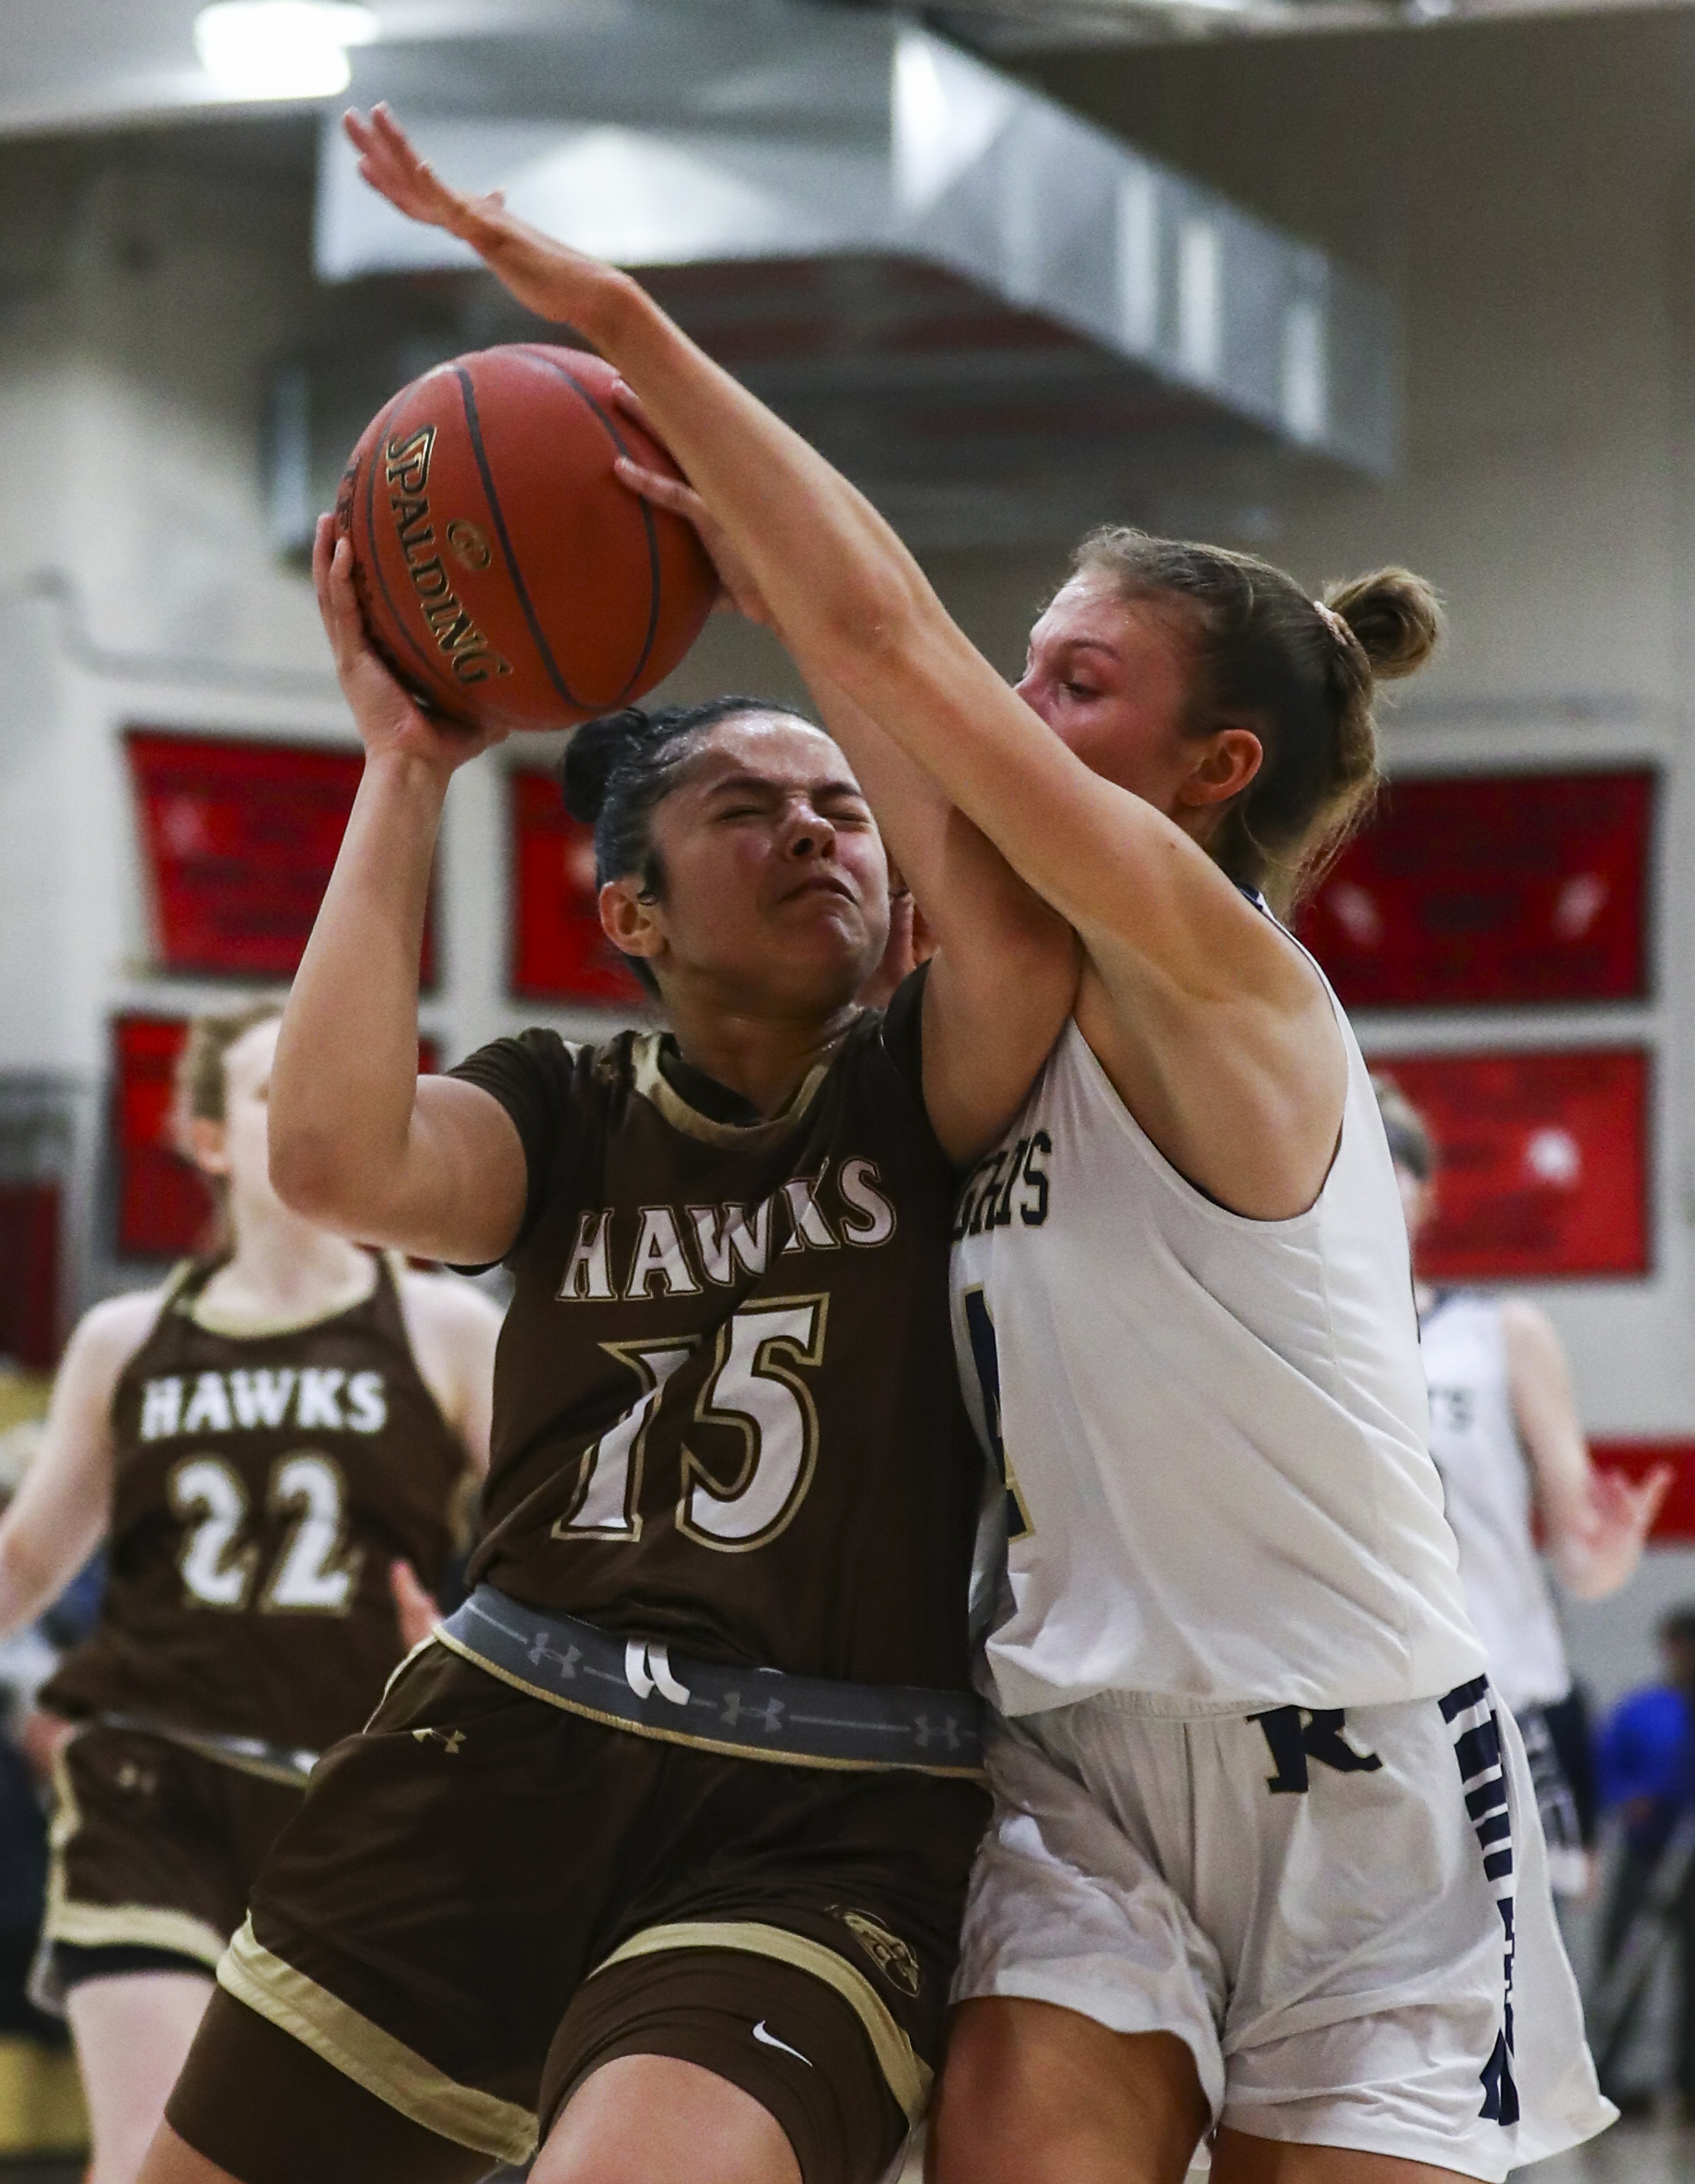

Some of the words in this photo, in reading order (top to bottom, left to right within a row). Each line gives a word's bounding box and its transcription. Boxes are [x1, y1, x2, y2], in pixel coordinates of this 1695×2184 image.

[386, 423, 513, 685] SPALDING
[555, 1155, 897, 1302] HAWKS
[139, 1366, 387, 1441] HAWKS
[551, 1292, 830, 1553] 15
[166, 1452, 366, 1617] 22
